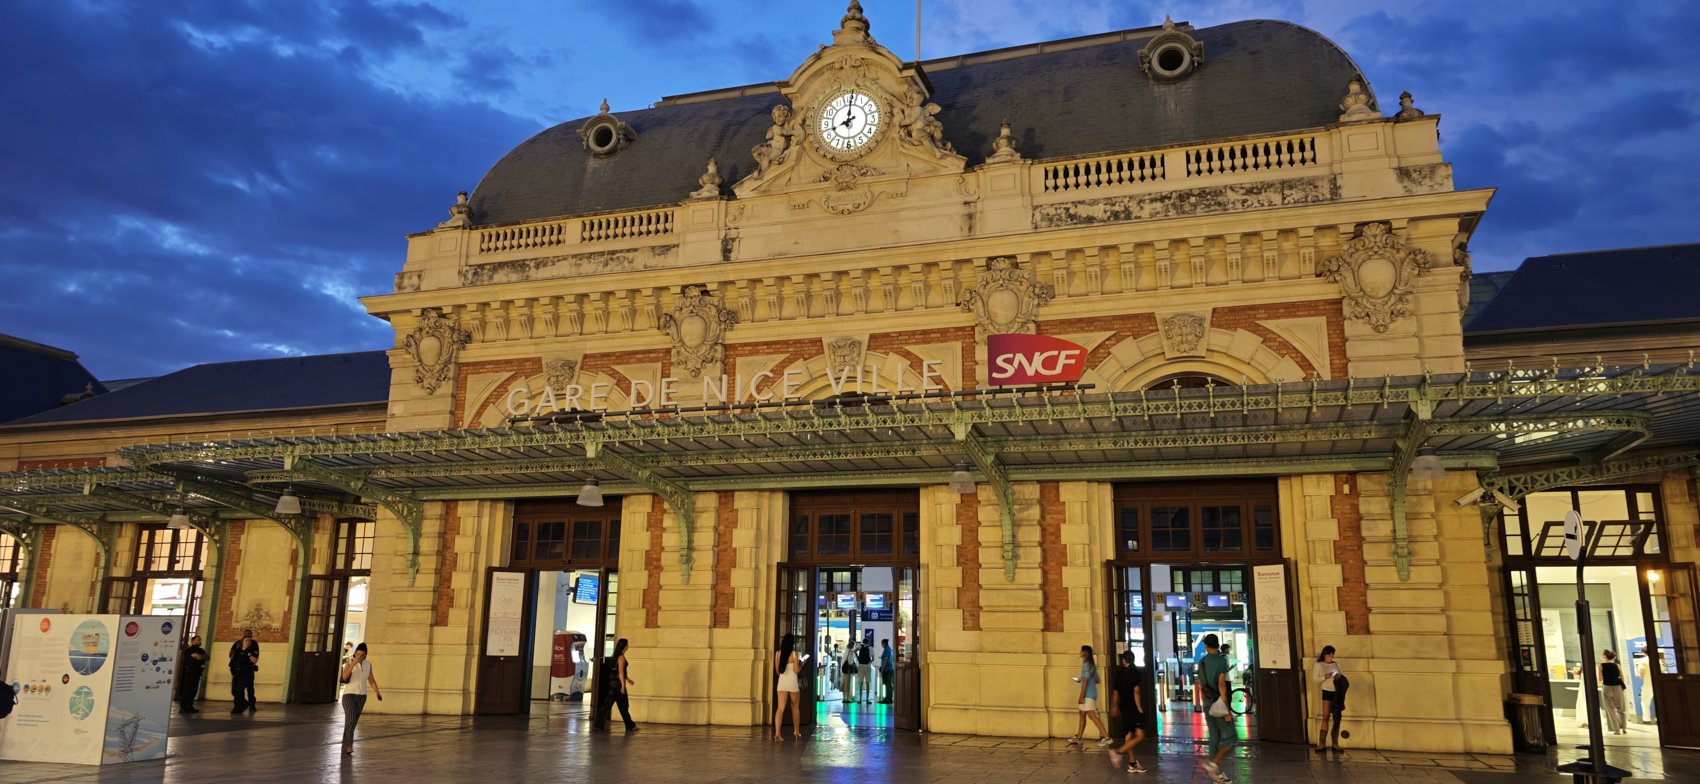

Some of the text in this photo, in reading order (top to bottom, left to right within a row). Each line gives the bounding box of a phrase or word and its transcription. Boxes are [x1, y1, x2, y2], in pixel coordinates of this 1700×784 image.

[870, 115, 876, 123] 3
[836, 139, 840, 147] 7
[859, 136, 863, 144] 5
[846, 141, 852, 149] 6
[991, 349, 1081, 379] SNCF
[506, 359, 943, 416] GARE DE NICE VILLE
